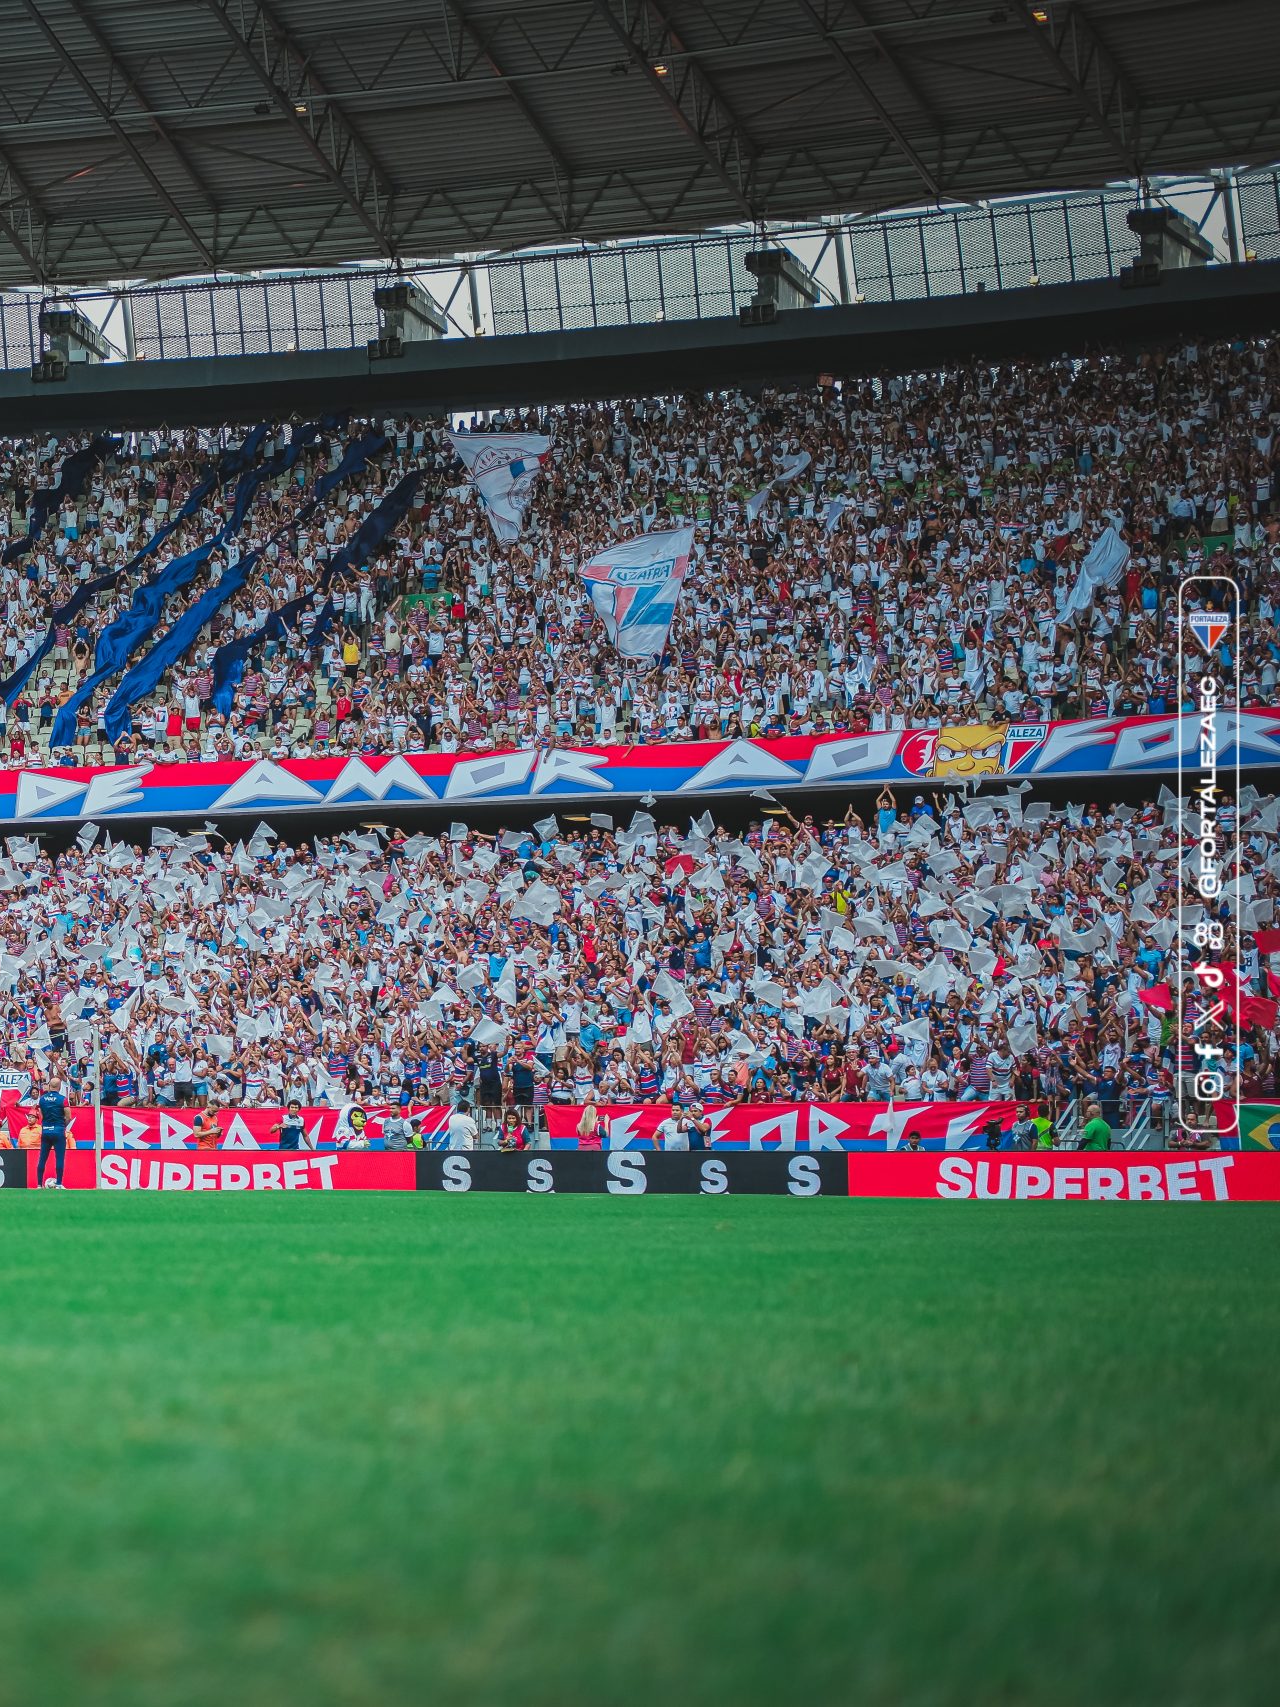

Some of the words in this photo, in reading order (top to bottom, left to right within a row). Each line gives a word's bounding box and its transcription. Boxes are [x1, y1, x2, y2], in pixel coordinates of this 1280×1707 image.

[1007, 727, 1043, 738] ALEZA
[15, 763, 155, 819] DE
[209, 749, 615, 811] AMOR
[679, 730, 903, 792] AO
[100, 1154, 339, 1190] SUPERBET
[442, 1155, 472, 1192] S
[527, 1158, 553, 1193] S
[607, 1152, 647, 1194] S
[700, 1159, 728, 1194] S
[787, 1155, 822, 1196] S
[935, 1155, 1235, 1200] SUPERBET
